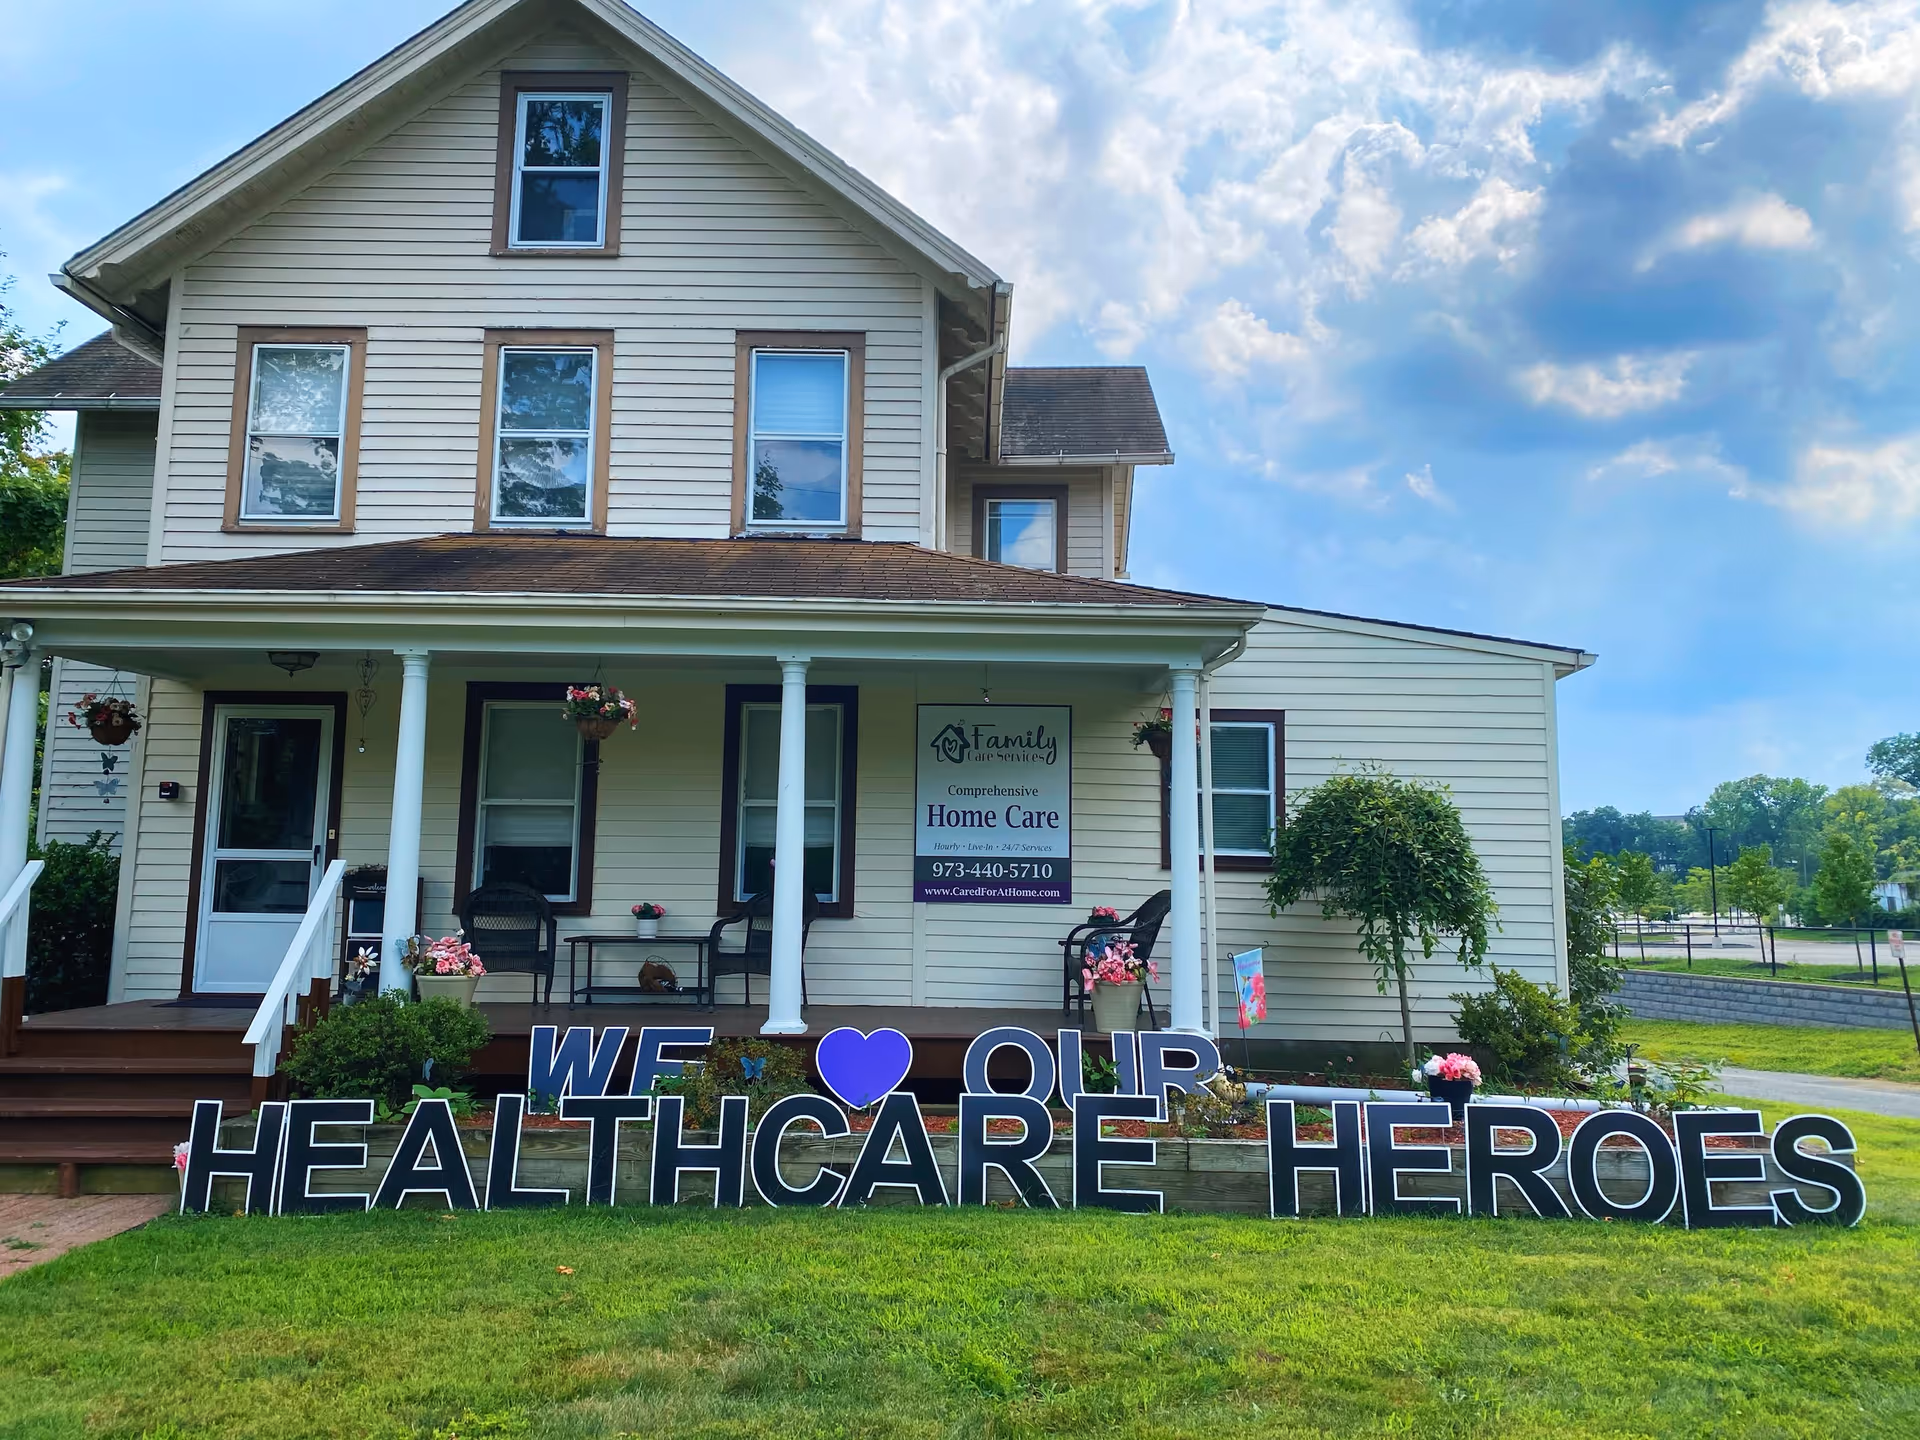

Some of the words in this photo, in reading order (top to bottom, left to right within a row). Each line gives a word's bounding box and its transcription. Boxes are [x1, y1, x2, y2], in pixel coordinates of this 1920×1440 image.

[971, 724, 1057, 765] Family
[967, 751, 993, 762] Care
[997, 751, 1045, 762] Services
[947, 785, 1039, 798] Comprehensive
[926, 804, 997, 828] Home
[1005, 805, 1059, 829] Care
[933, 843, 961, 851] Hourly
[967, 843, 993, 851] Live-In
[1022, 844, 1052, 852] Services
[932, 862, 1052, 879] 973-440-5710
[924, 887, 1060, 897] www.CaredForAtHome.com
[528, 1026, 714, 1116] WE
[963, 1026, 1222, 1122] OUR
[180, 1093, 1165, 1215] HEALTHCARE
[1267, 1099, 1867, 1230] HEROES
